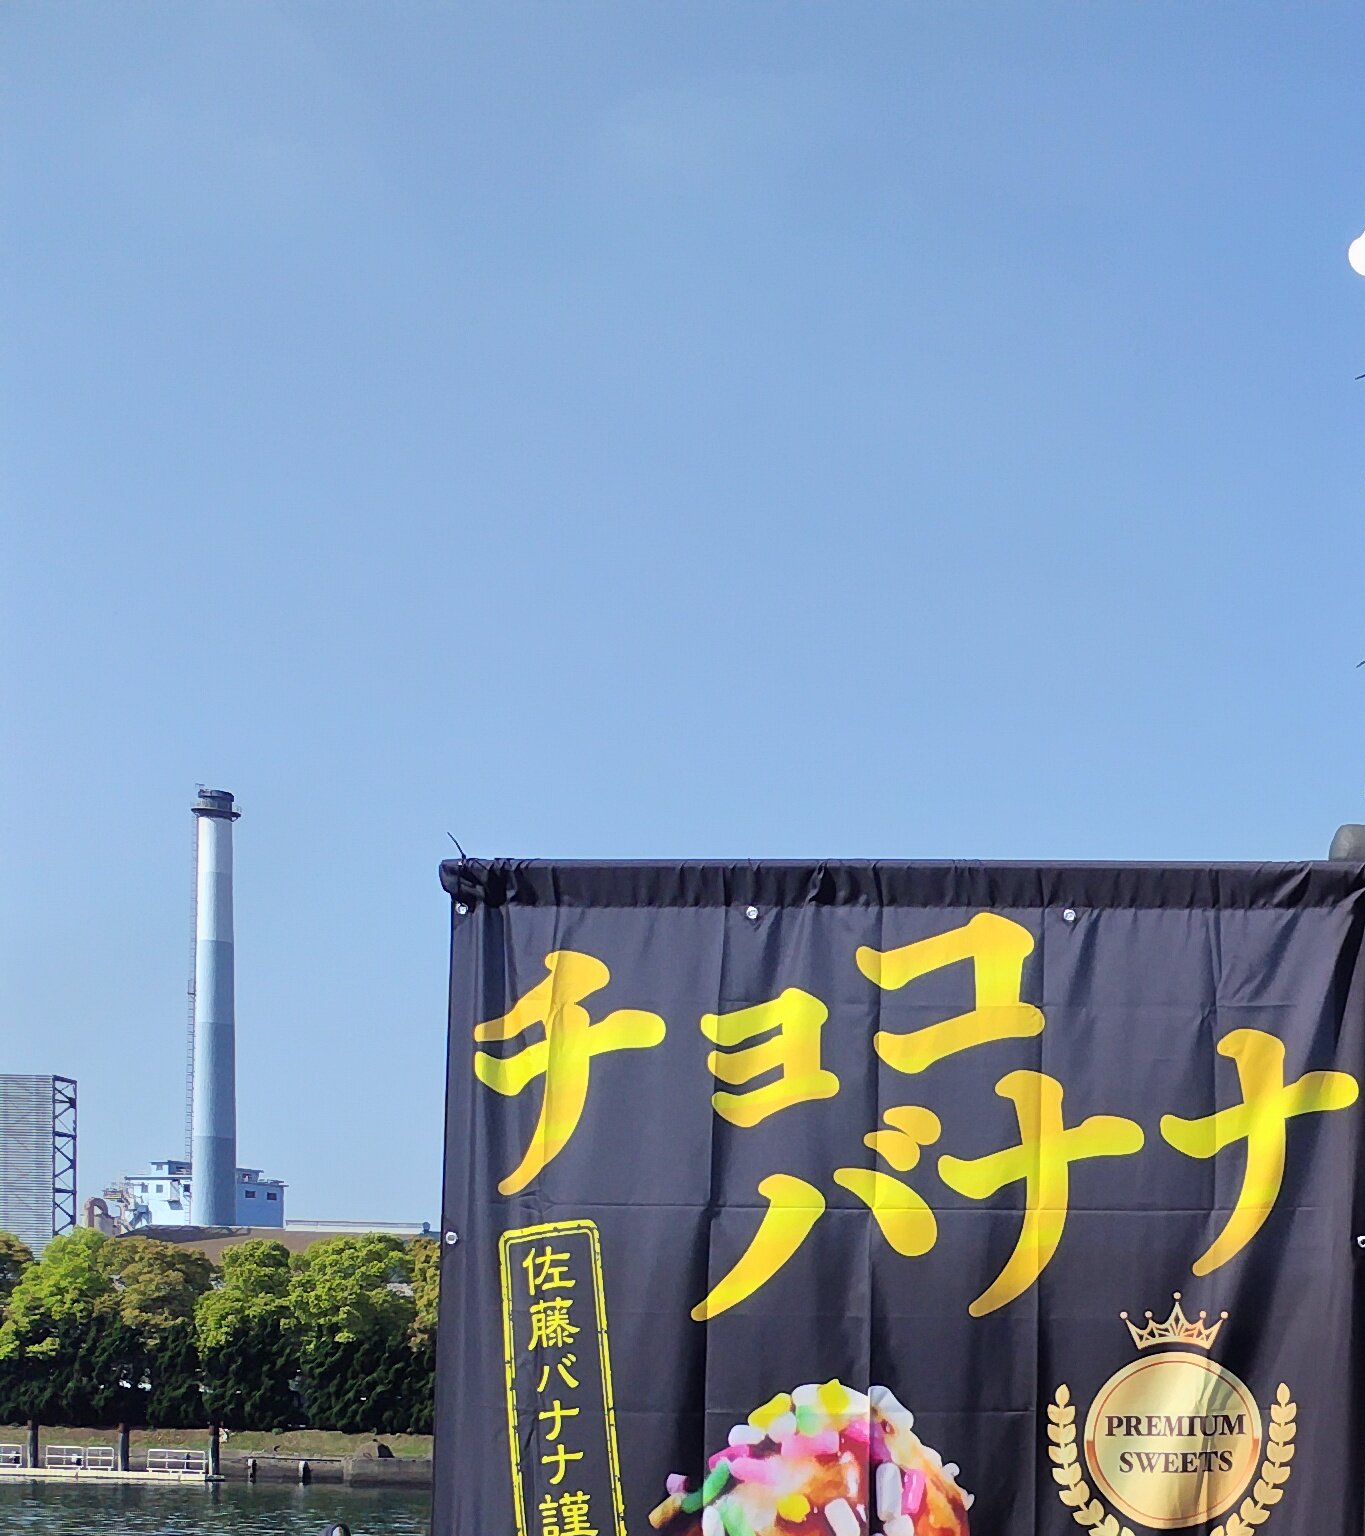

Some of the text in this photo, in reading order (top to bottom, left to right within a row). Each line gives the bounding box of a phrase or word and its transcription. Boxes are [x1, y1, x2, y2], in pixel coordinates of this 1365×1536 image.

[474, 912, 1045, 1196] チョコ
[691, 1028, 1359, 1321] バナナ
[1104, 1414, 1247, 1437] PREMIUM
[1119, 1451, 1233, 1474] SWEETS
